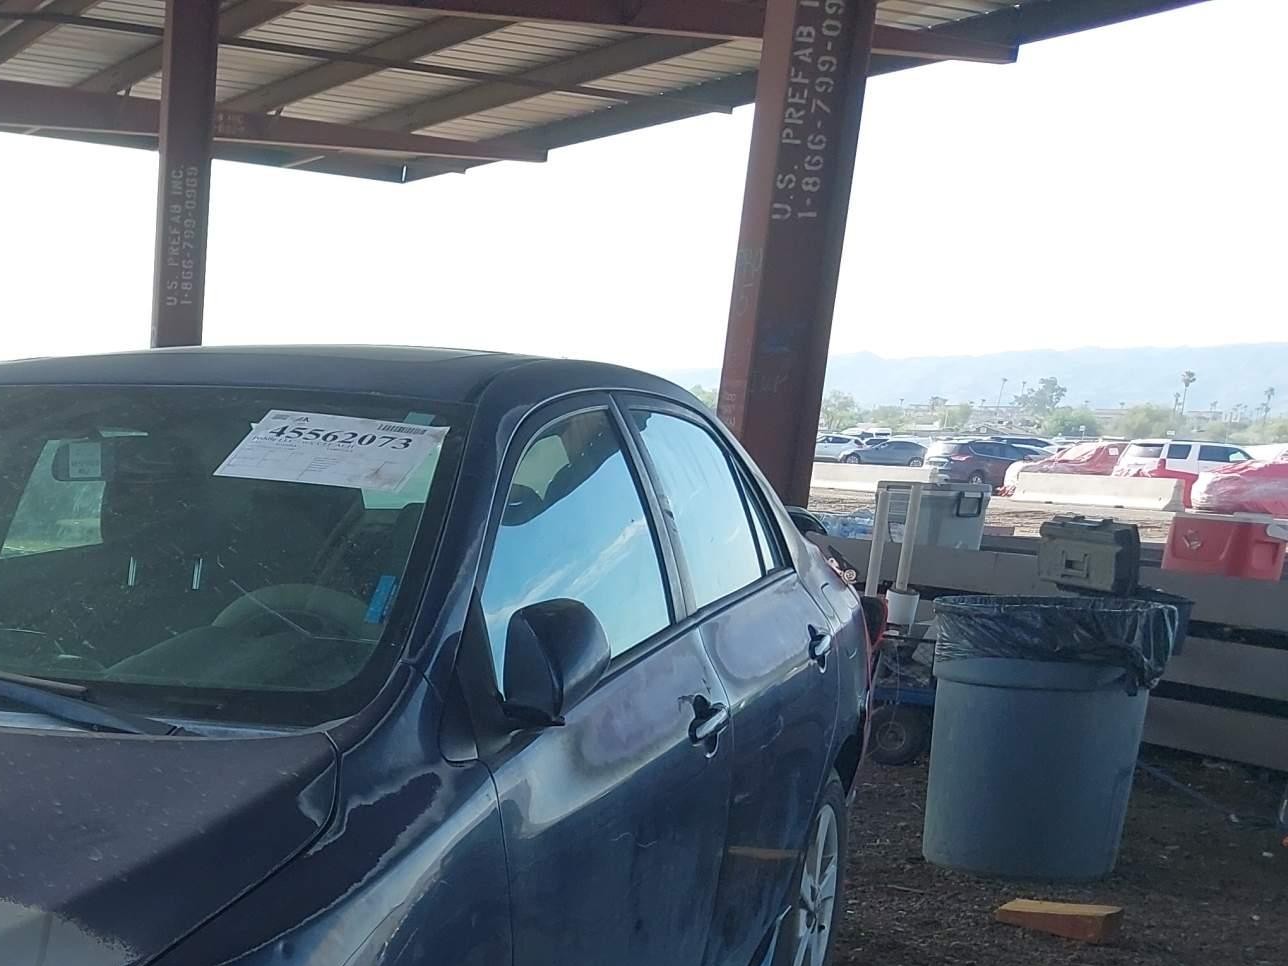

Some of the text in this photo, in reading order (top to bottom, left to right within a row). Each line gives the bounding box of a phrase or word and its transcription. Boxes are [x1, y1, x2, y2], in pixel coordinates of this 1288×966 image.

[781, 25, 816, 145] PREFAB
[770, 164, 799, 220] U.S.
[168, 204, 183, 266] PREFAB
[166, 275, 179, 306] U.S.
[269, 424, 414, 450] 45562073
